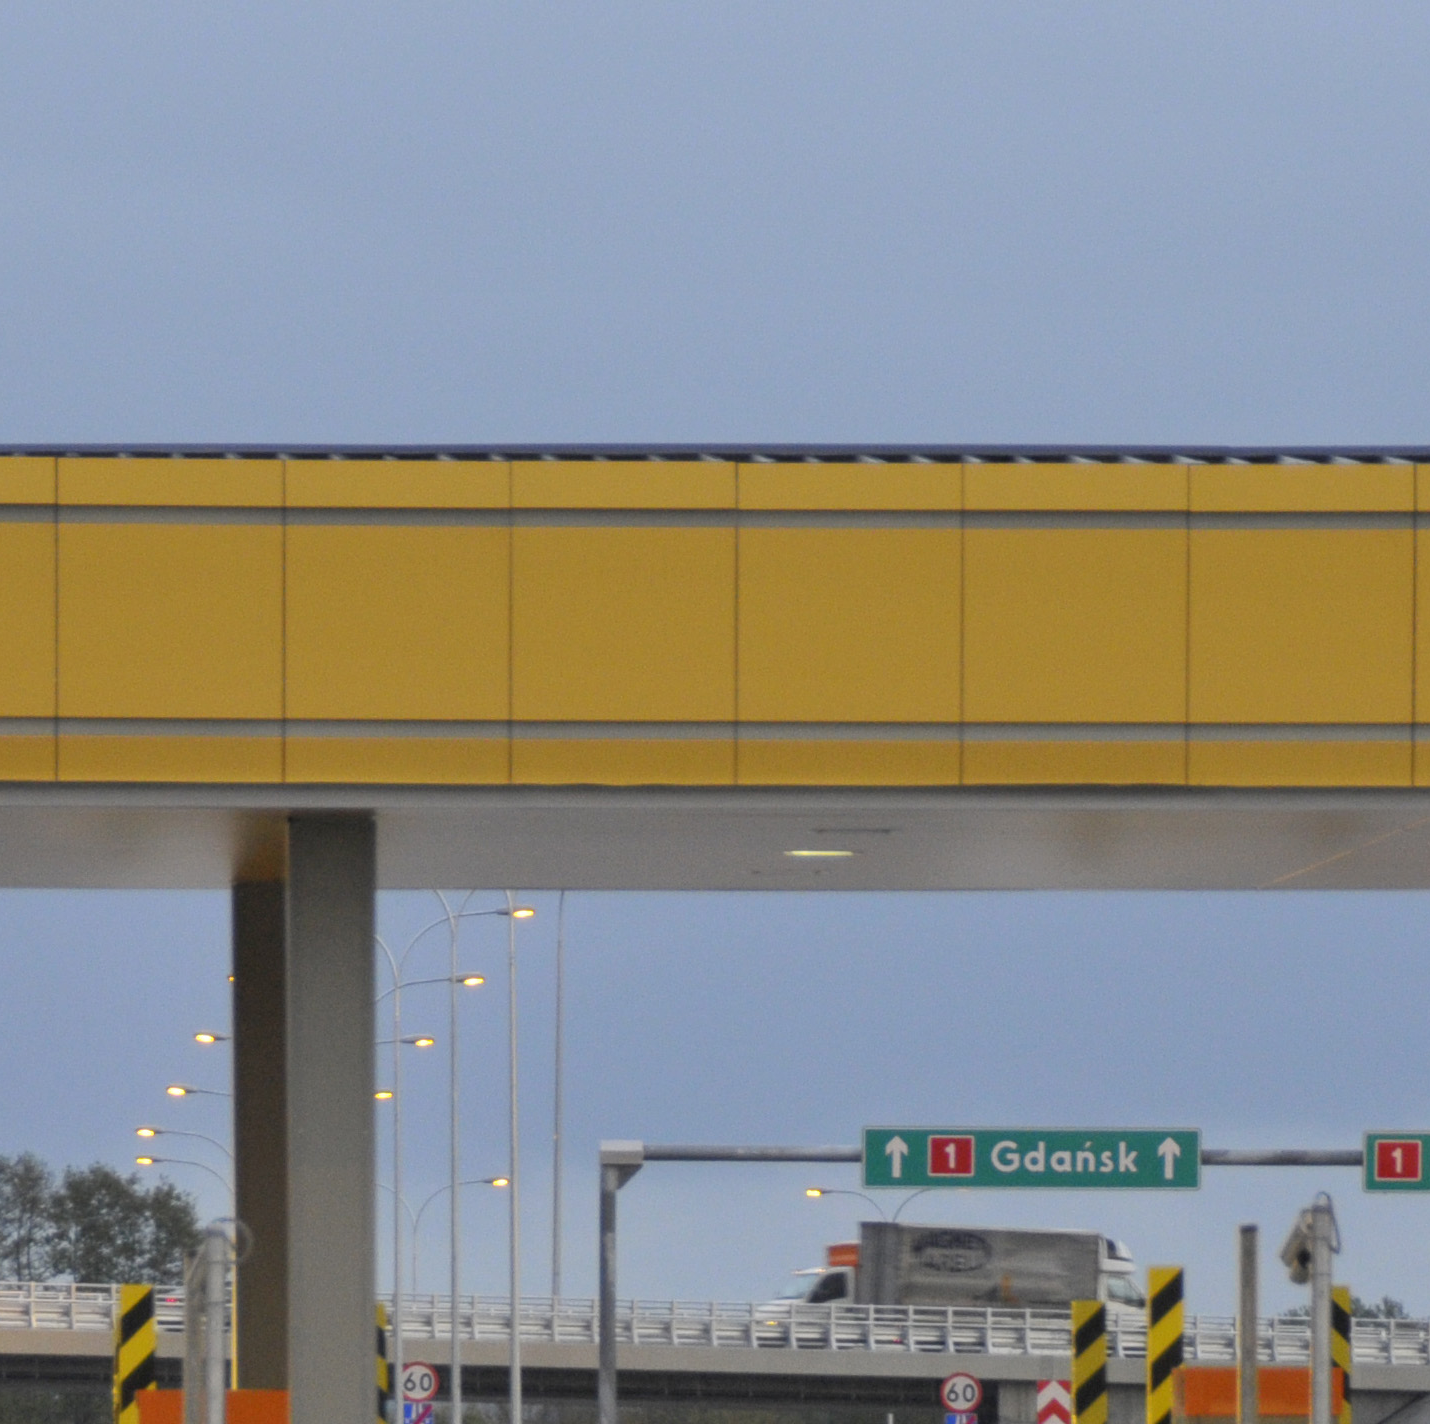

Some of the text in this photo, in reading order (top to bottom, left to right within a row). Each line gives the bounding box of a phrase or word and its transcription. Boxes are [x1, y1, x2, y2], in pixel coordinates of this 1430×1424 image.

[943, 1139, 1140, 1173] 1 Gdańsk
[1390, 1146, 1404, 1174] 1
[403, 1371, 433, 1392] 60
[946, 1382, 976, 1403] 60
